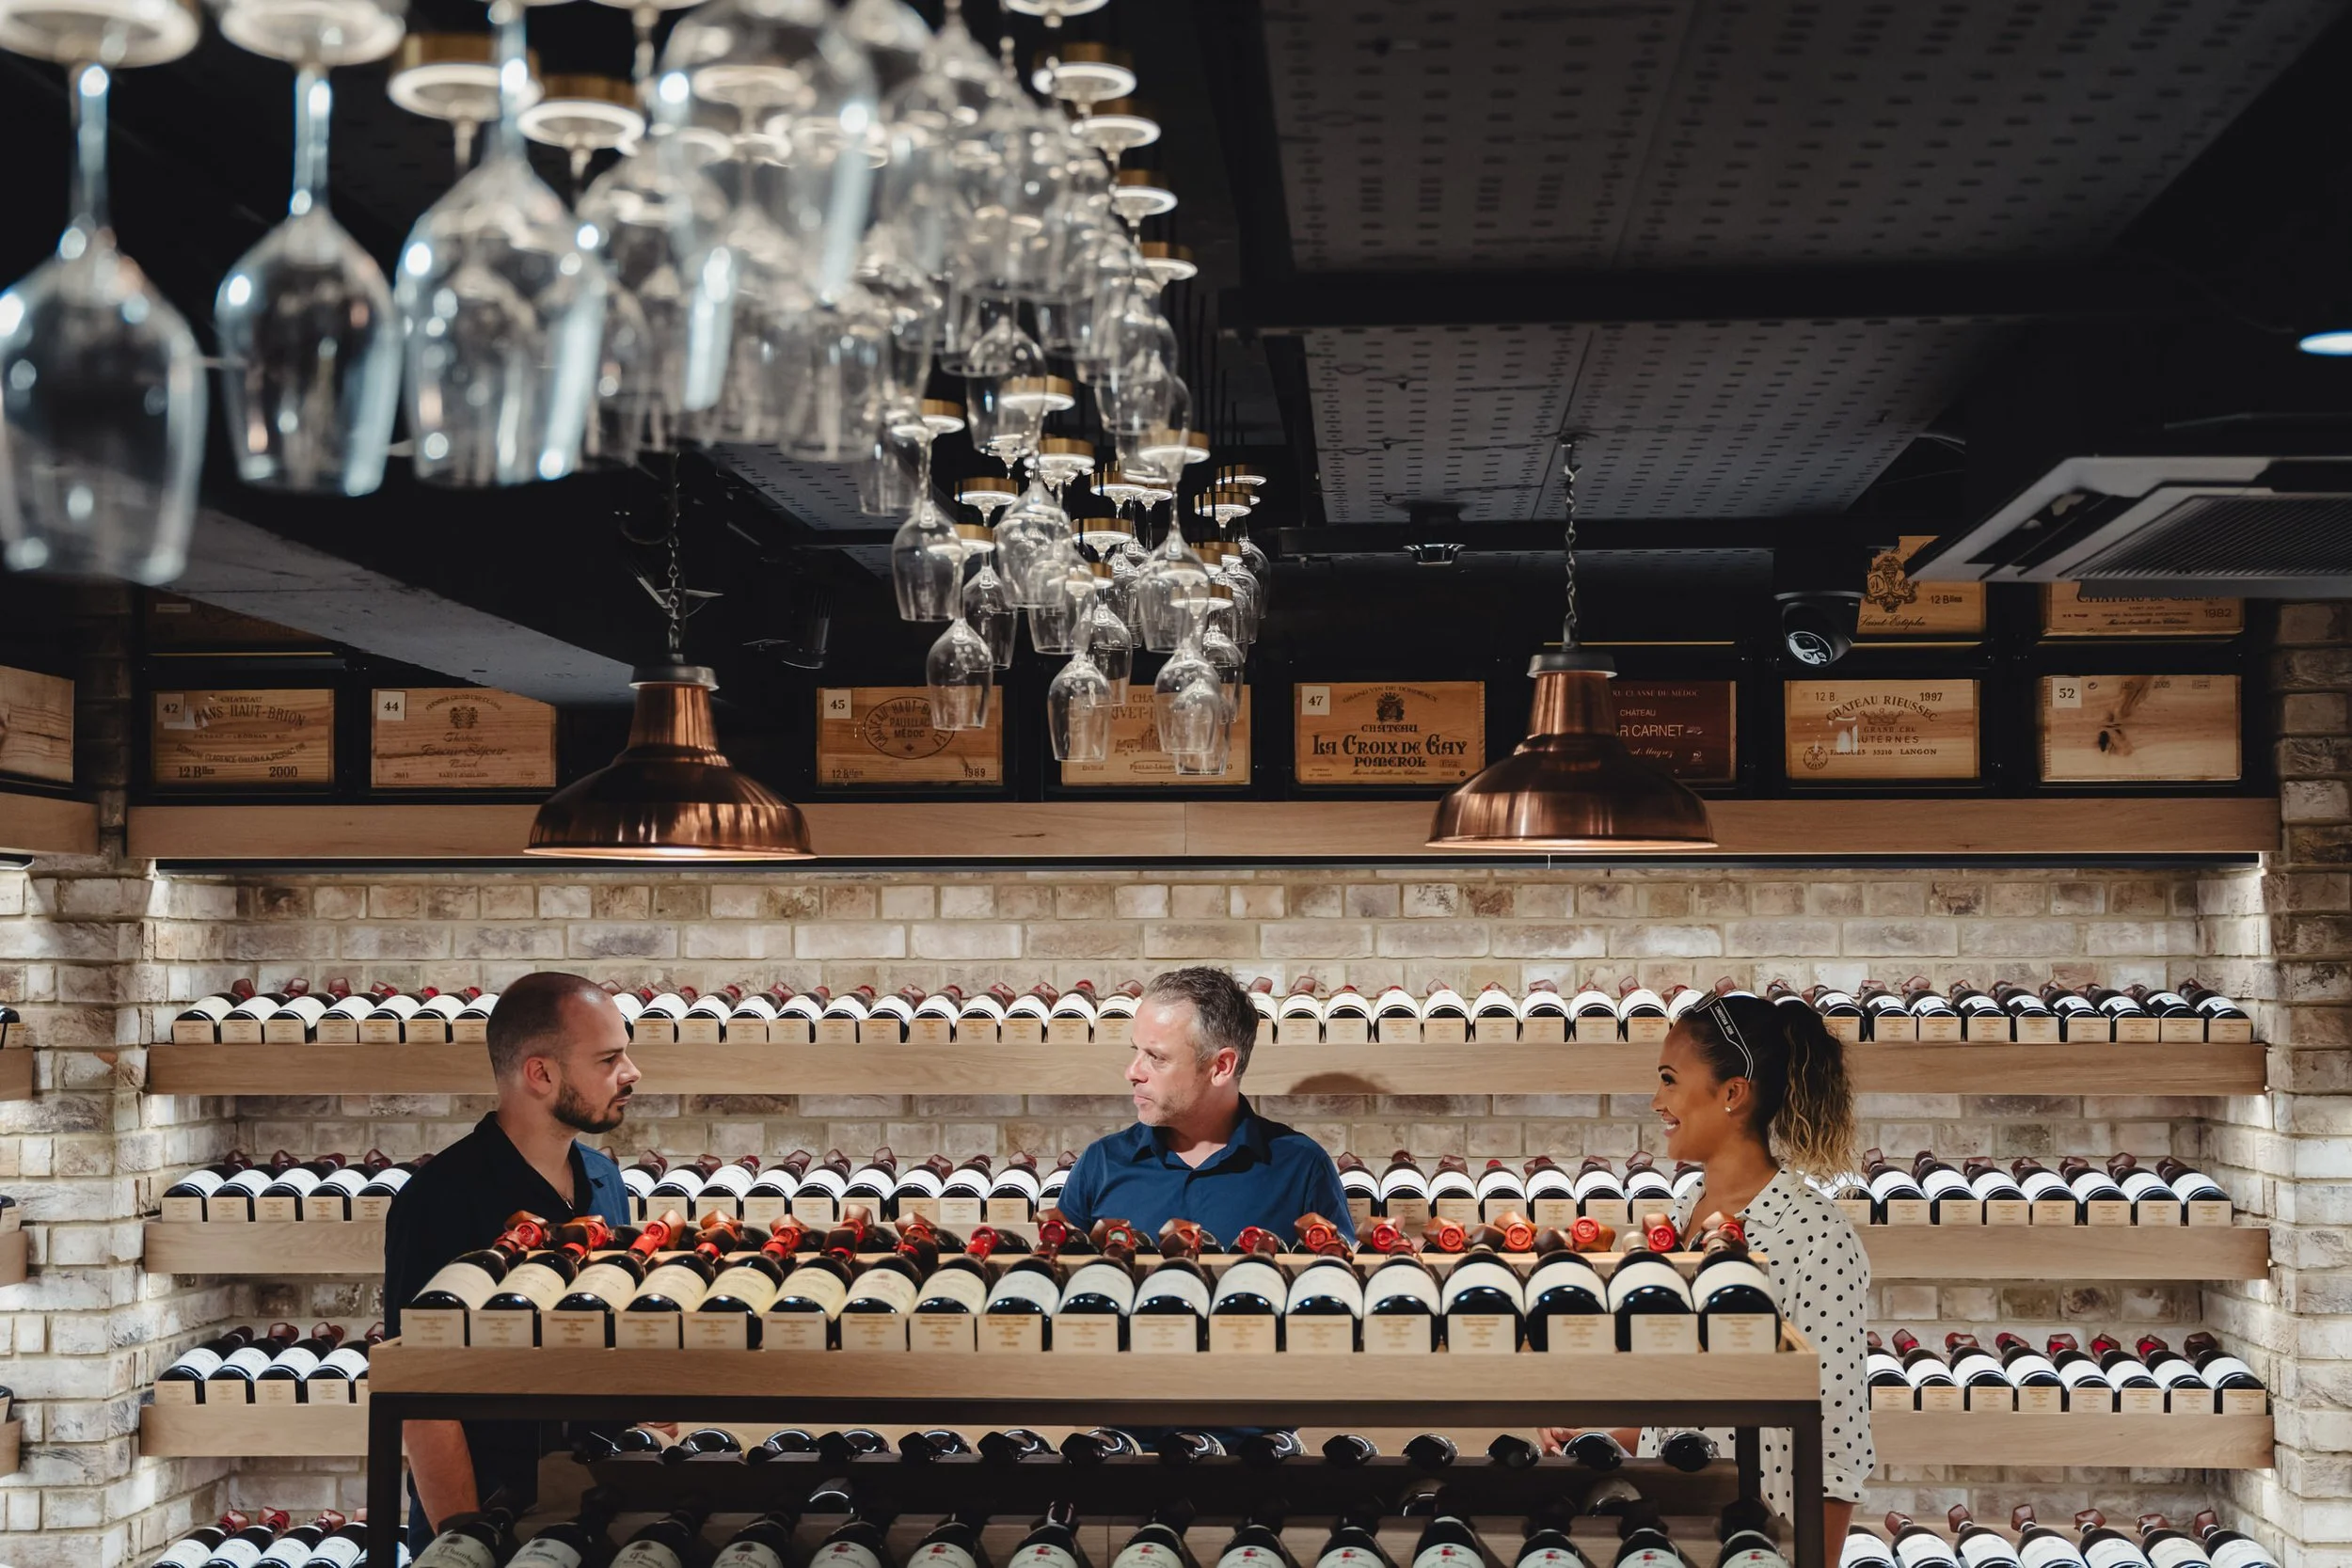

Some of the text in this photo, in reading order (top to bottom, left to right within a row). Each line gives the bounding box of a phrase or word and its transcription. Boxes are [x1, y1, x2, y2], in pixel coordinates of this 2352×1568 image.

[1931, 595, 1940, 604] 12
[2204, 609, 2232, 618] 1982
[1815, 691, 1825, 702] 12
[1919, 691, 1944, 702] 1997
[2058, 688, 2075, 699] 52
[830, 699, 846, 710] 45
[1308, 695, 1324, 706] 47
[163, 703, 179, 714] 42
[384, 701, 400, 712] 44
[1825, 695, 1939, 722] CHATEAU RIEUSSEC
[230, 704, 307, 727] HAUT-BRION
[1361, 723, 1418, 733] CHATEAU
[1631, 724, 1684, 737] CARNET
[1354, 756, 1427, 768] POMEROL
[179, 766, 190, 779] 12
[268, 766, 298, 778] 2000
[832, 769, 842, 779] 12
[964, 767, 986, 778] 1989
